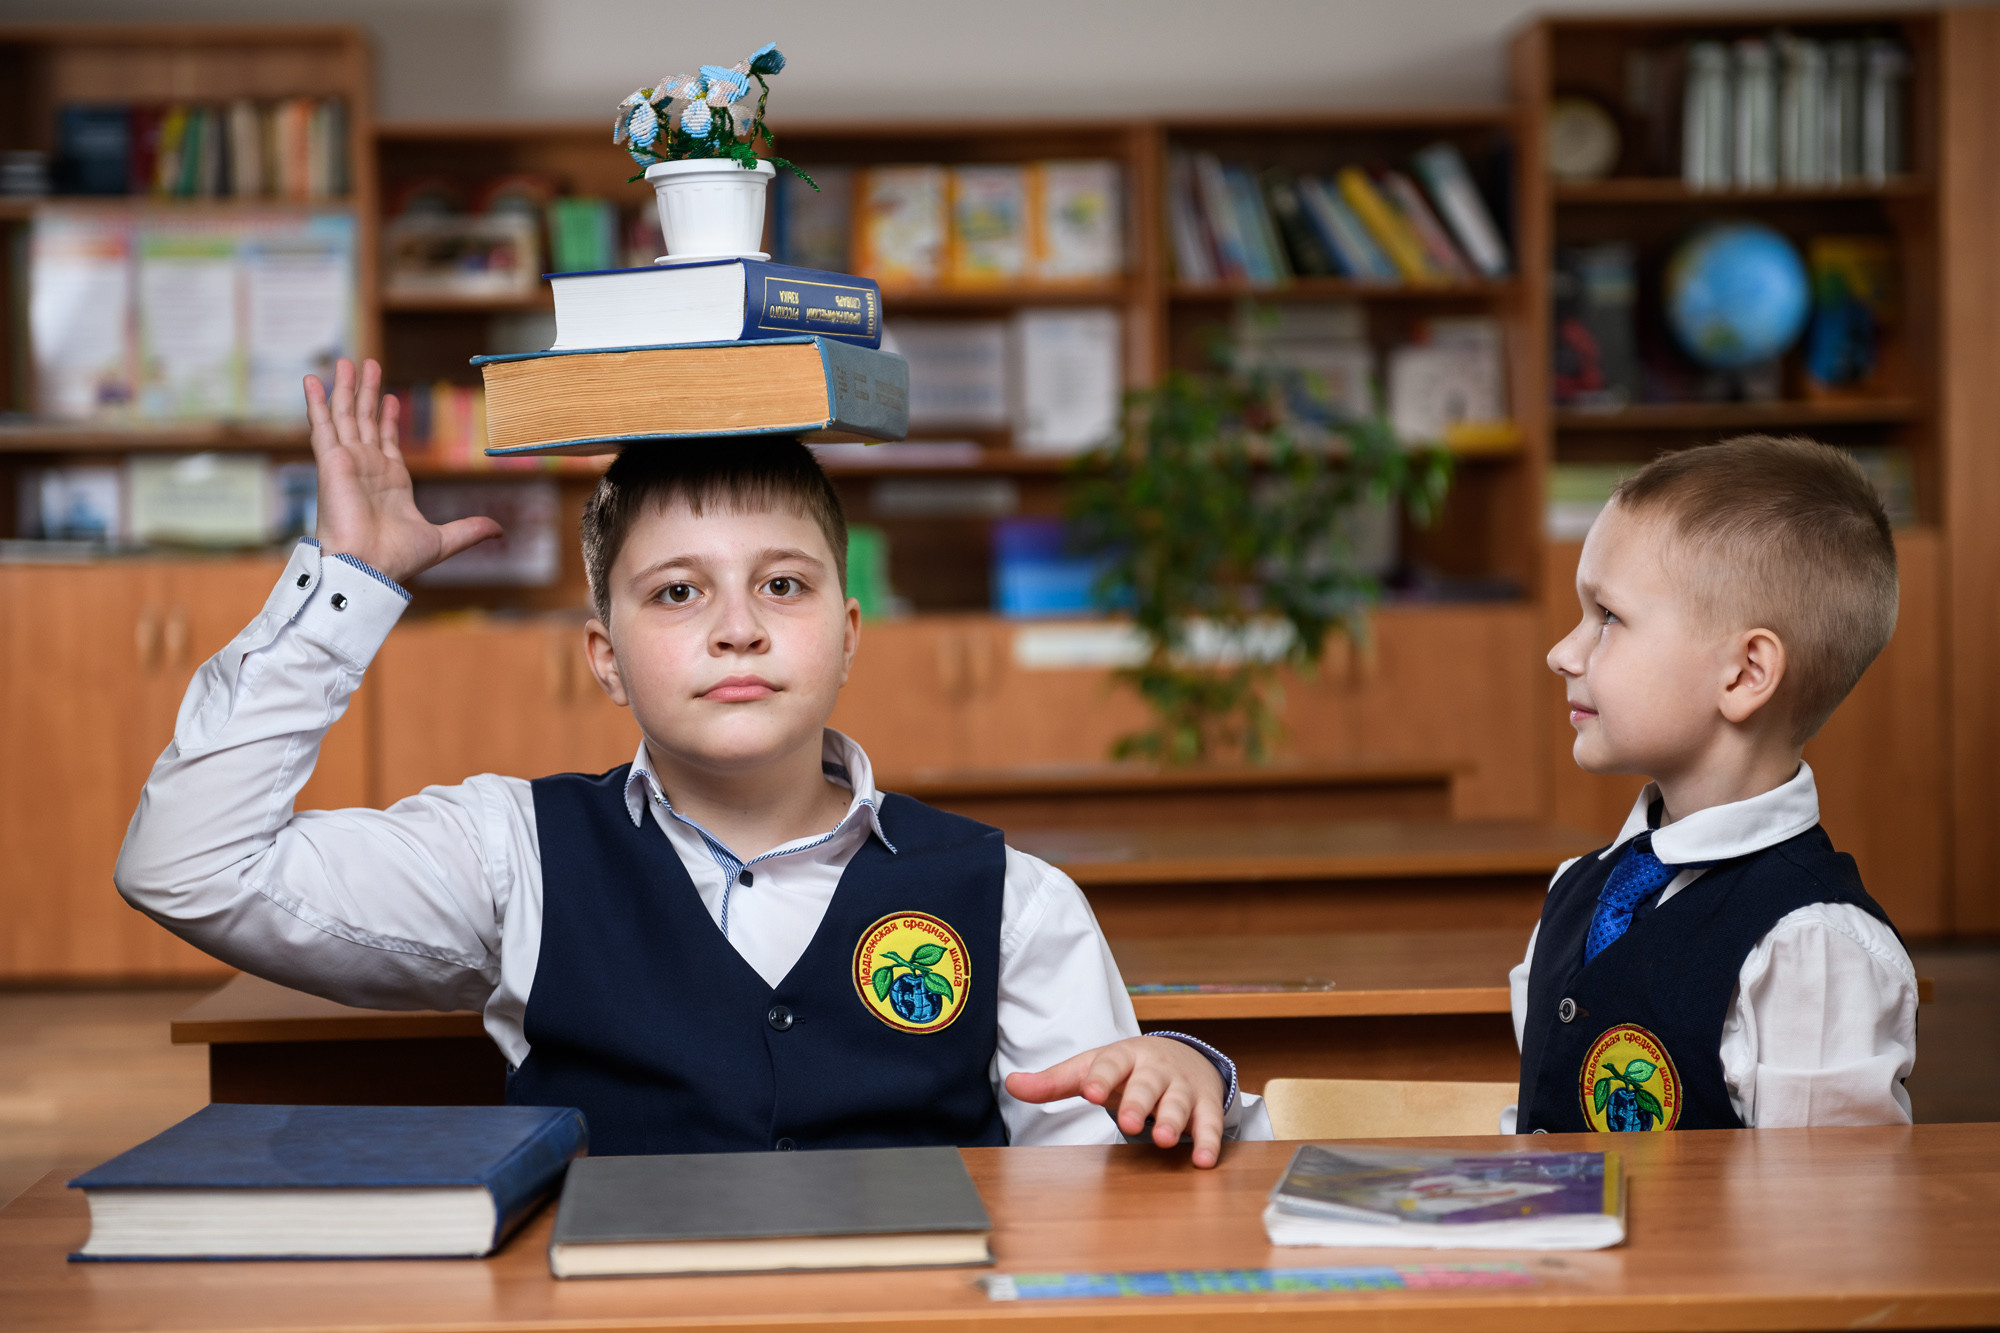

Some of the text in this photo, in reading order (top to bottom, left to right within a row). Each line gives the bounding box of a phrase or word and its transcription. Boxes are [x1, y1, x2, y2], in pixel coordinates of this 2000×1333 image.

[779, 290, 799, 304] ЯЗЫКА
[835, 295, 861, 308] СЛОВАРЬ
[769, 305, 799, 320] РУССКОГО
[865, 292, 874, 334] НОВЫЙ
[860, 919, 962, 987] Медвенская средняя школа
[1584, 1031, 1672, 1108] Медвенская средняя школа
